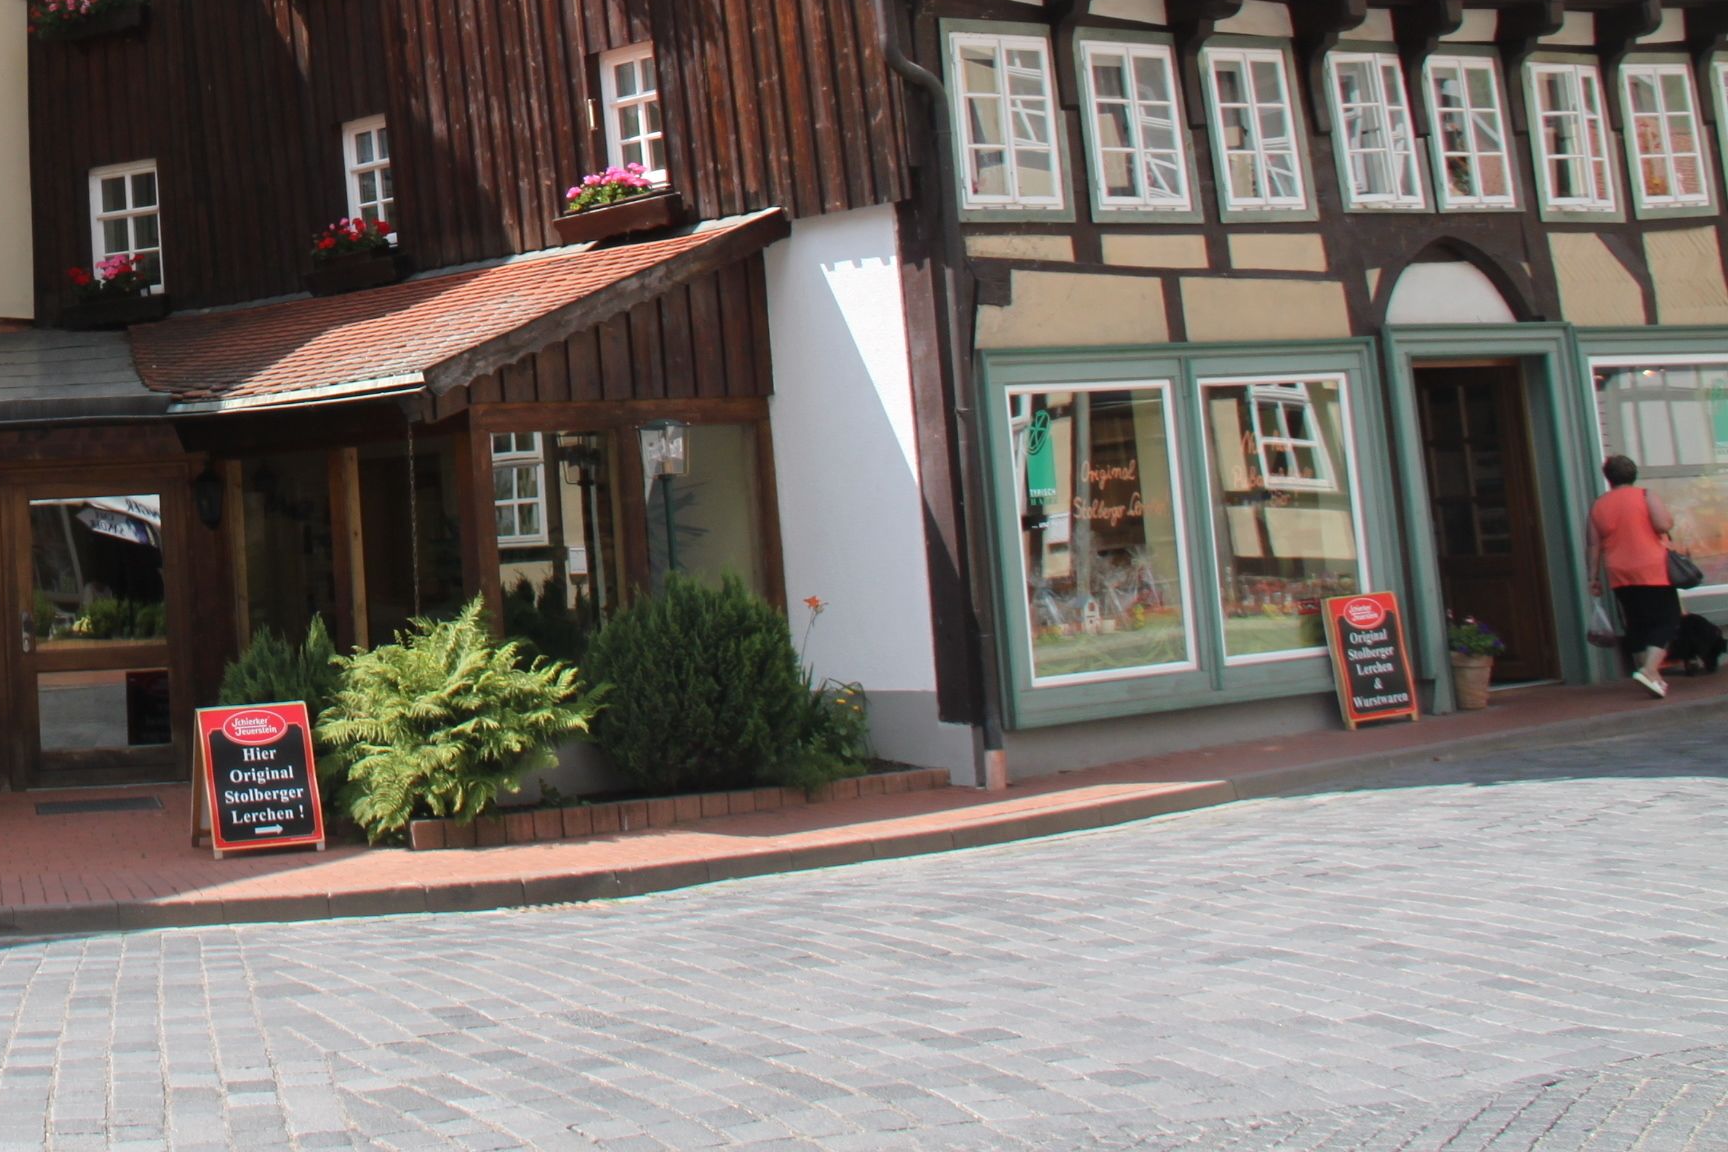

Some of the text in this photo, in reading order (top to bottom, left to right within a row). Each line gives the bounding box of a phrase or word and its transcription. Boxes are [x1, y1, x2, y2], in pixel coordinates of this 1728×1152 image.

[1080, 459, 1136, 490] Original
[1349, 629, 1388, 645] Original
[1347, 646, 1394, 661] Stolberger
[1356, 661, 1394, 676] Lerchen
[1373, 677, 1383, 689] &
[1353, 692, 1409, 708] Wurstwaren
[242, 747, 277, 762] Hier
[229, 765, 294, 785] Original
[224, 787, 304, 804] Stolberger
[231, 807, 294, 824] Lerchen
